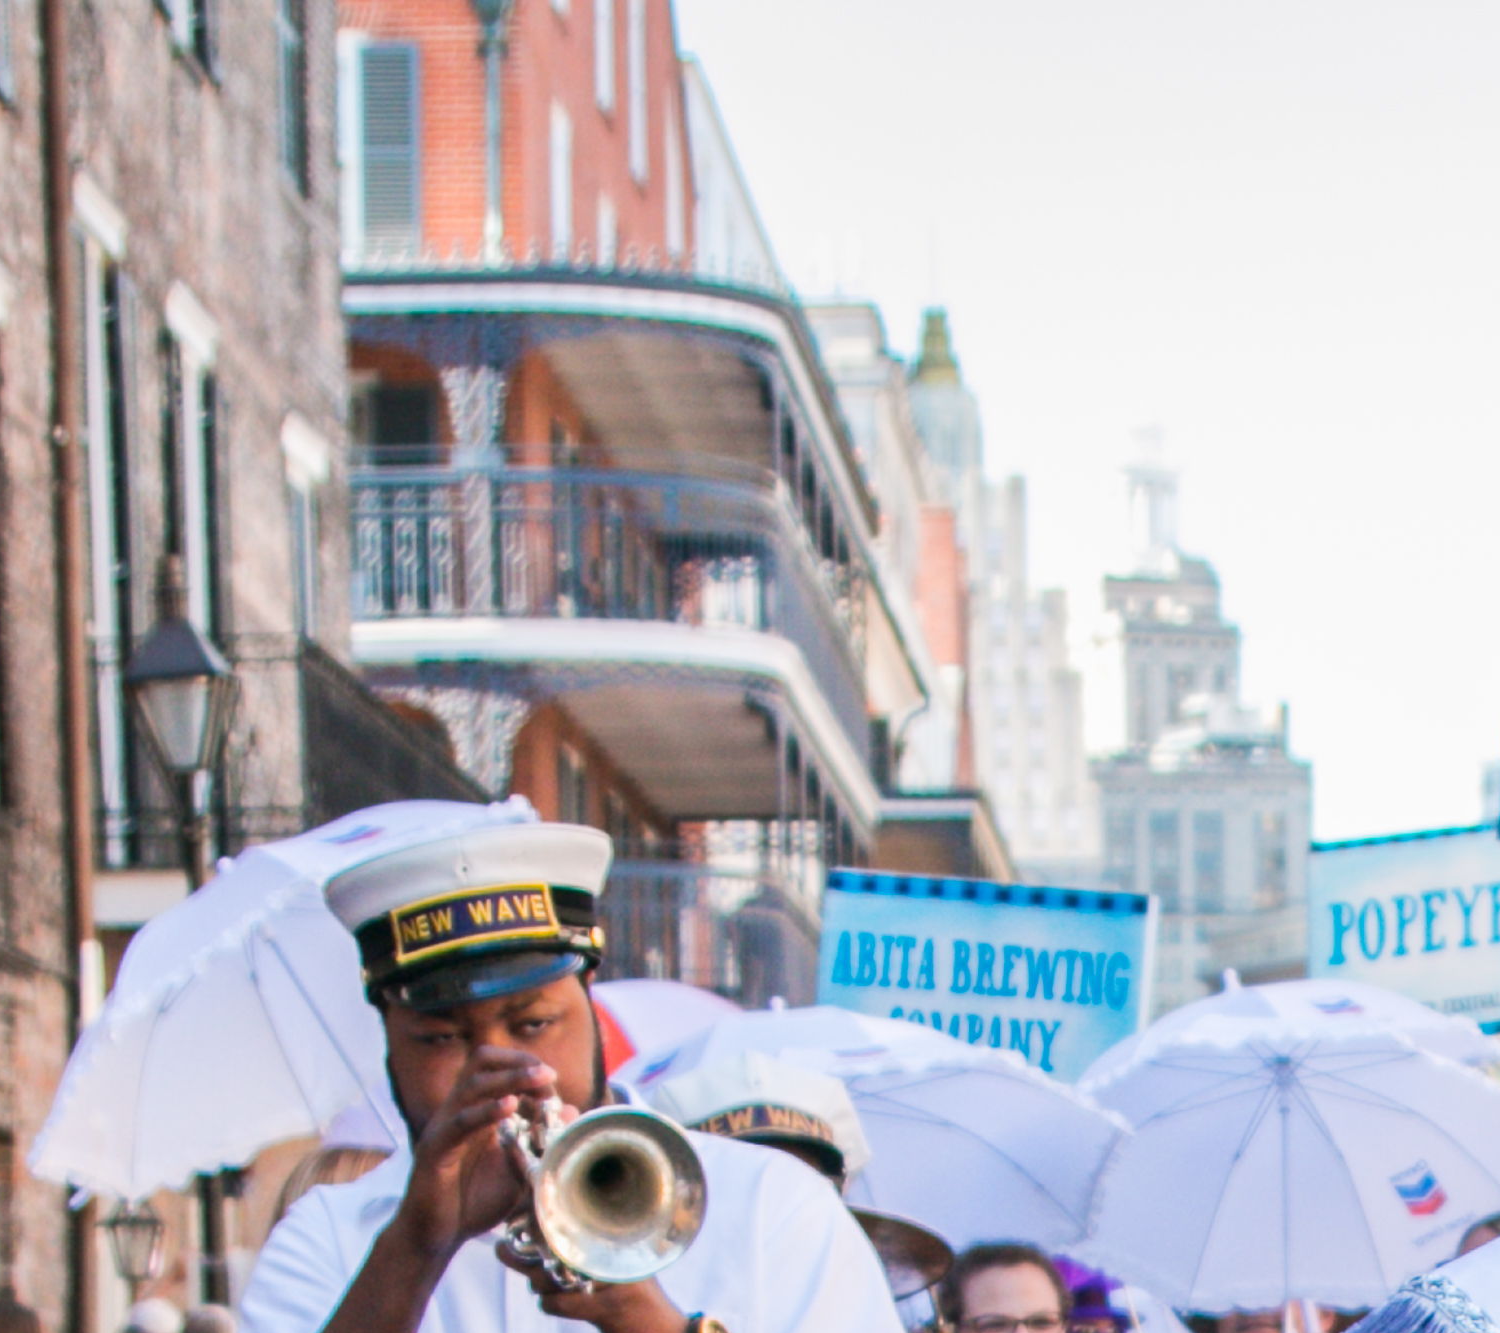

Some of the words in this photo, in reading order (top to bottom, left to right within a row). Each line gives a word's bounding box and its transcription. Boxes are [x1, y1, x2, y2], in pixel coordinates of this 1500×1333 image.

[402, 906, 453, 943] NEW
[467, 894, 548, 926] WAVE
[831, 930, 936, 990] ABITA
[950, 939, 1131, 1012] BREWING
[890, 1006, 1062, 1072] PANY
